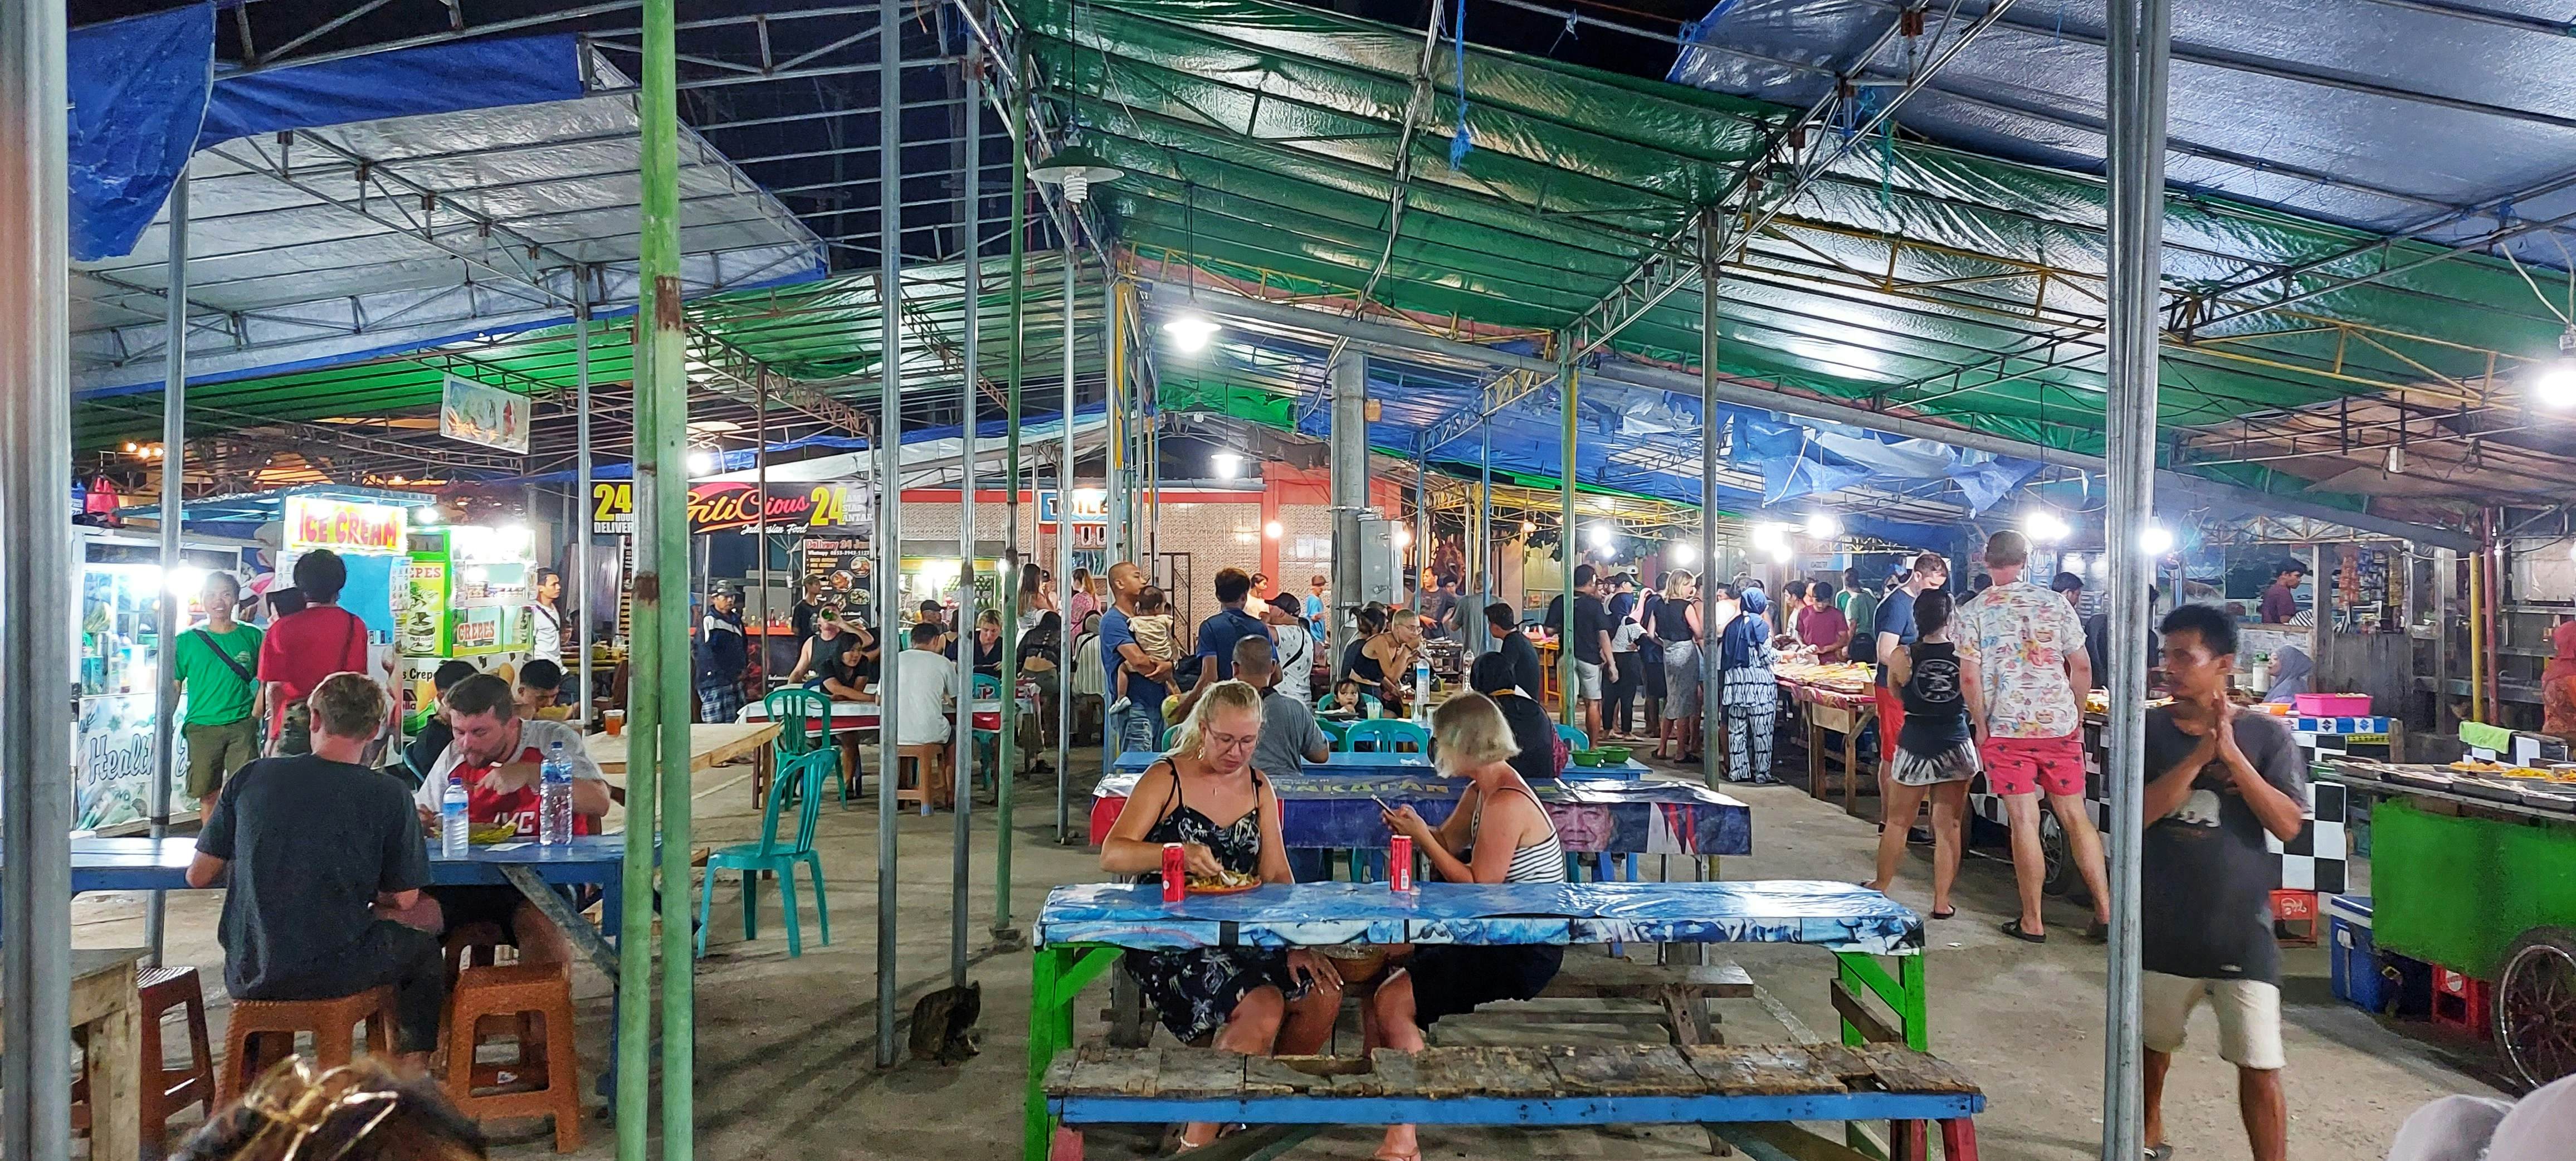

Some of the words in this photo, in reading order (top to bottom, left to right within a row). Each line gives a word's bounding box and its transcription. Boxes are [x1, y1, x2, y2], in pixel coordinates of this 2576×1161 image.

[593, 484, 632, 521] 24
[810, 486, 847, 526] 24
[299, 508, 330, 543] ICE
[335, 511, 397, 547] CREAM
[786, 521, 811, 535] Food
[841, 513, 873, 522] ANTAR
[458, 620, 495, 641] CREPES
